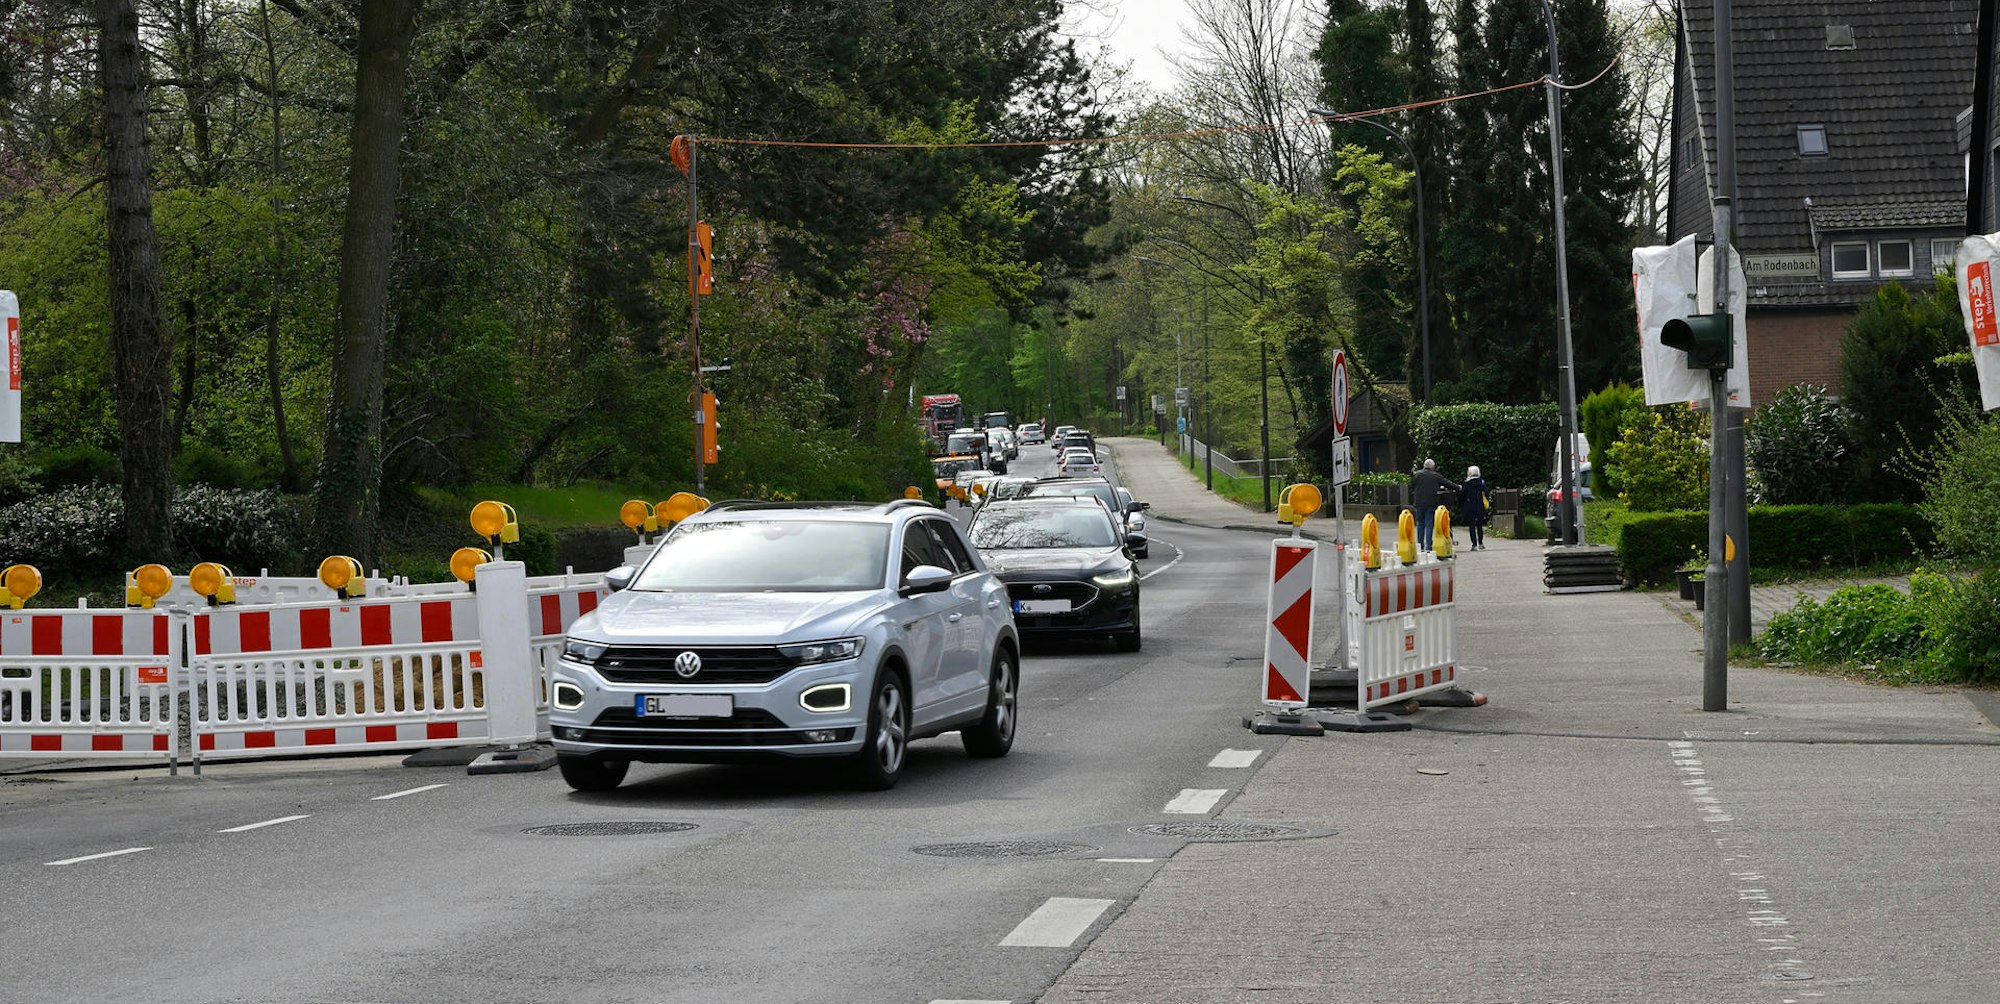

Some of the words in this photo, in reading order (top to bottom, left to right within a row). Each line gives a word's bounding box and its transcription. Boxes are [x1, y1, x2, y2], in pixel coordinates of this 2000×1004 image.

[1746, 261, 1762, 271] Am
[1764, 258, 1816, 271] Rodenbach
[1973, 298, 1985, 329] step
[232, 577, 257, 588] step
[646, 697, 665, 713] GL
